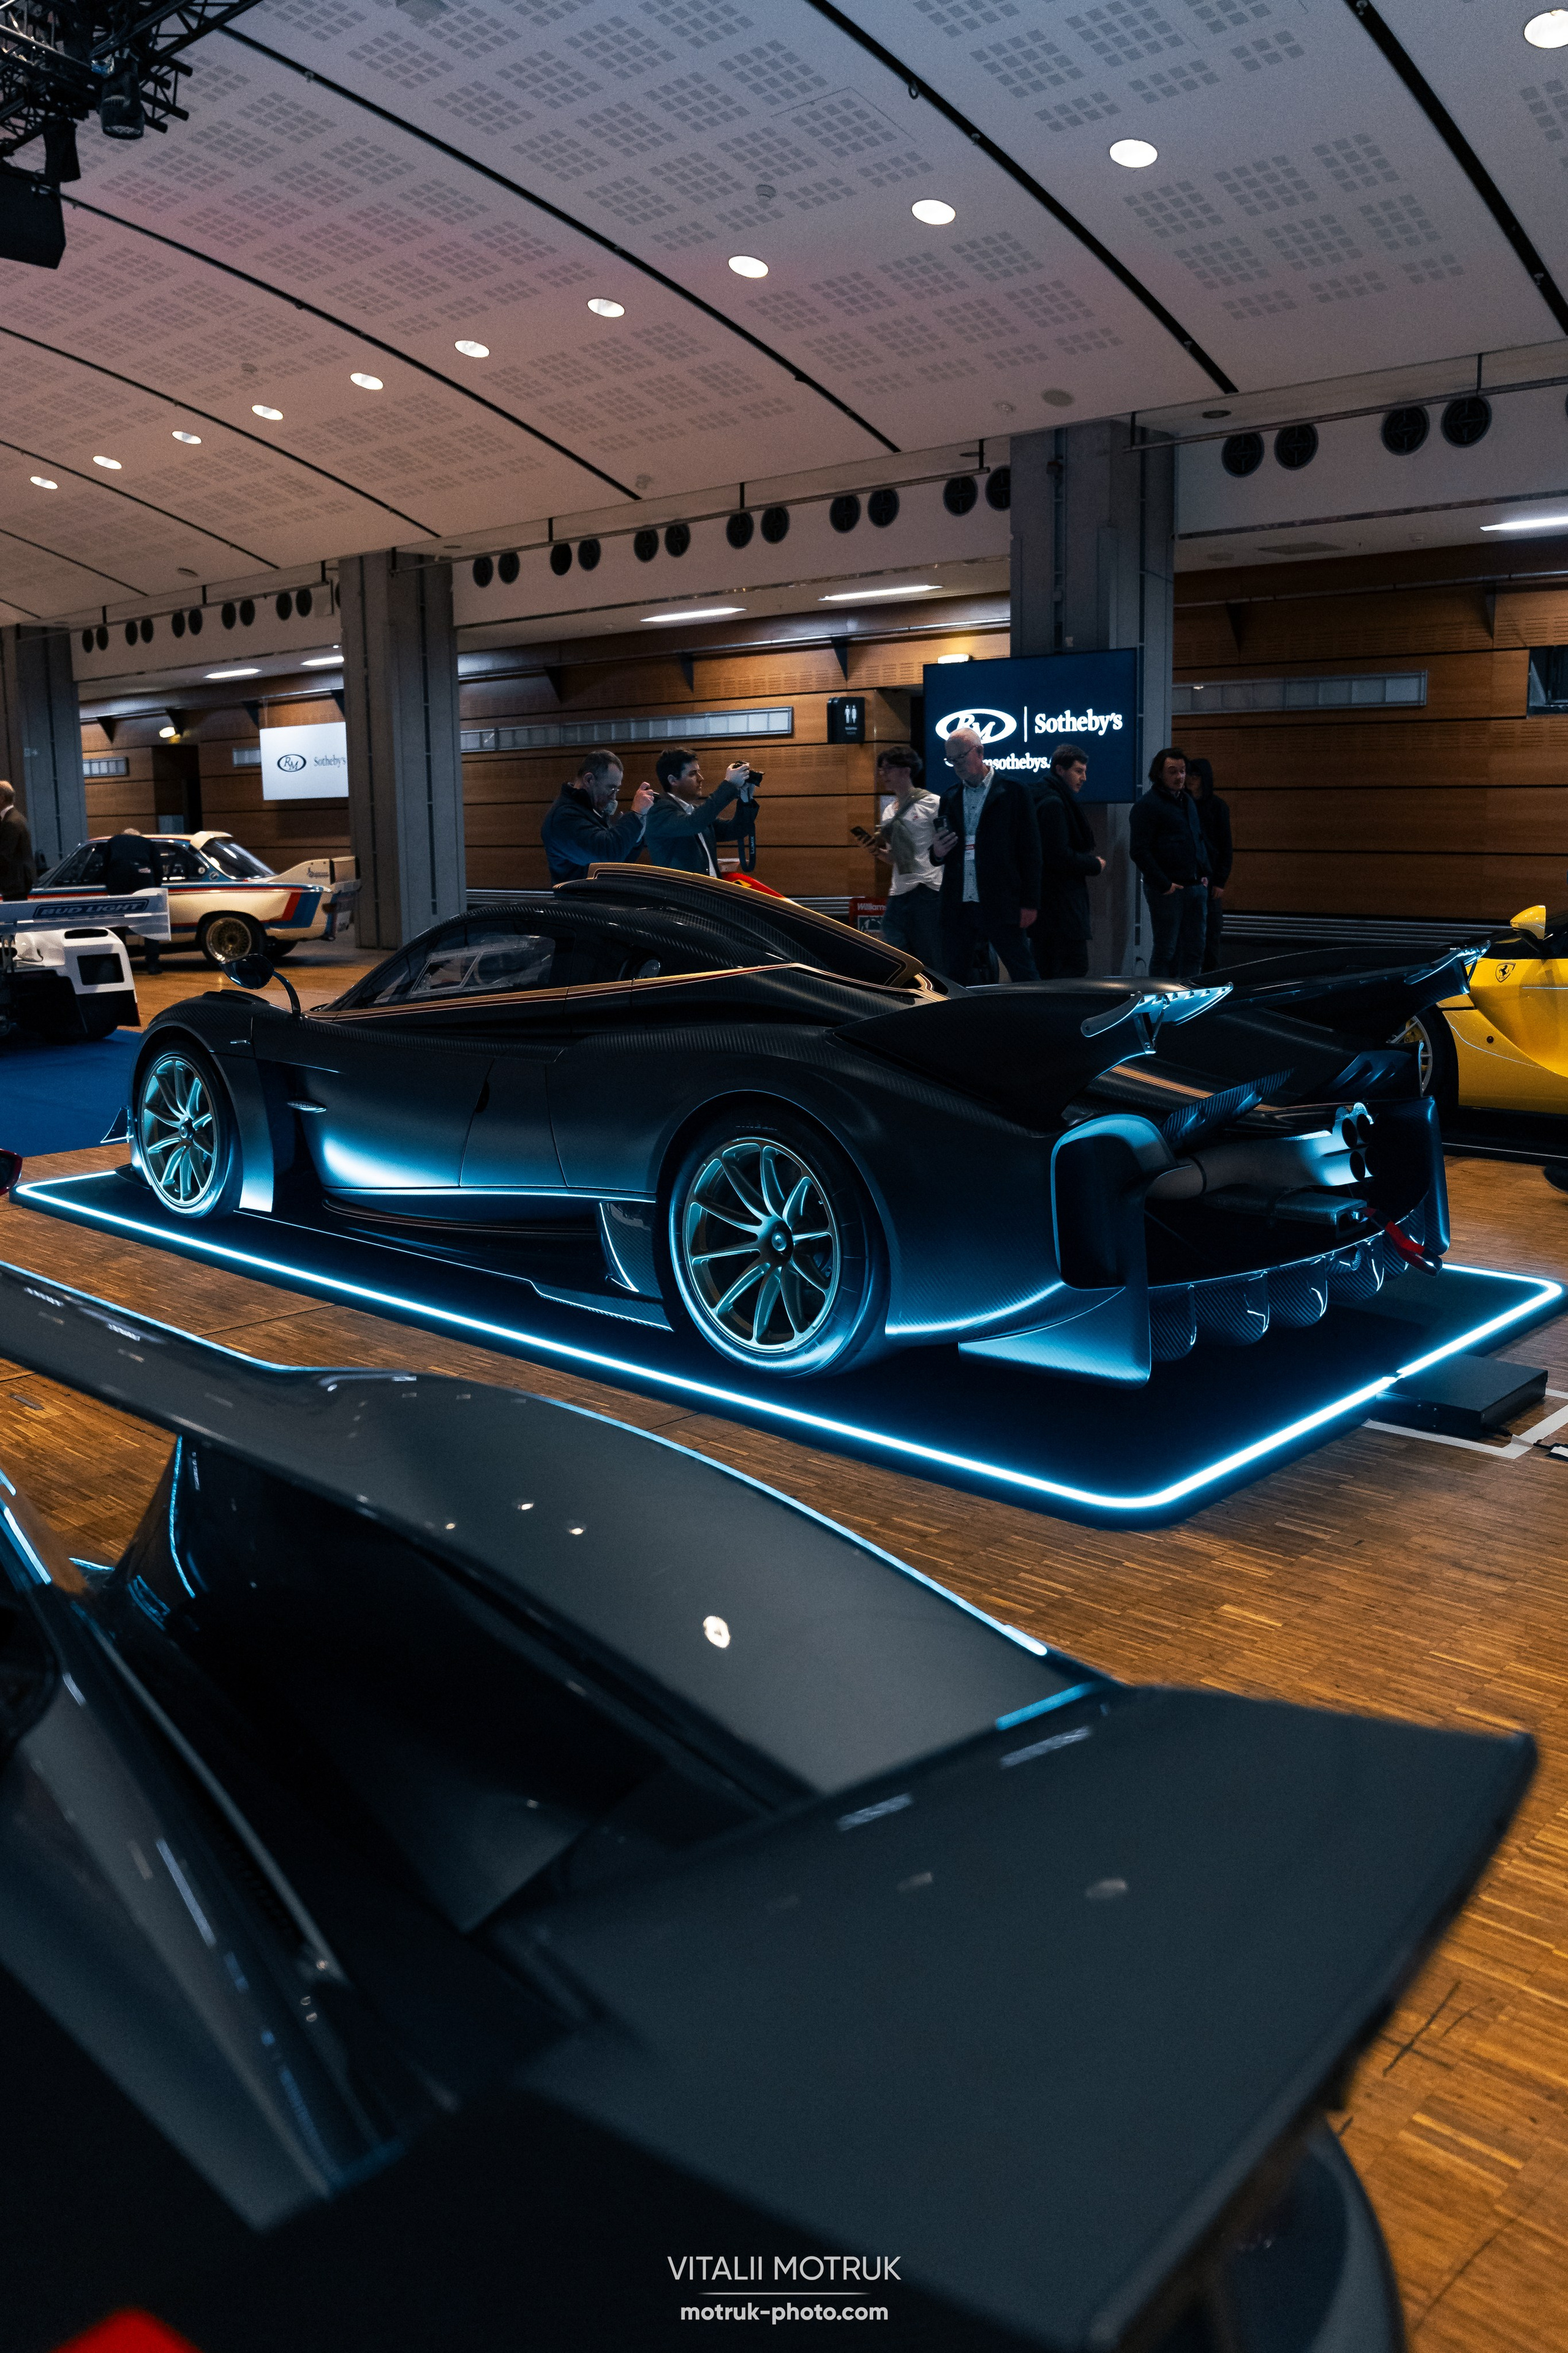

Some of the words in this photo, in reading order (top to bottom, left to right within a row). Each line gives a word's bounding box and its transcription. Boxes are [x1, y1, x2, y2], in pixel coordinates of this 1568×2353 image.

[1035, 708, 1123, 736] Sotheby's
[314, 754, 347, 768] Sotheby's
[40, 907, 83, 916] BUD
[86, 903, 143, 913] LIGHT
